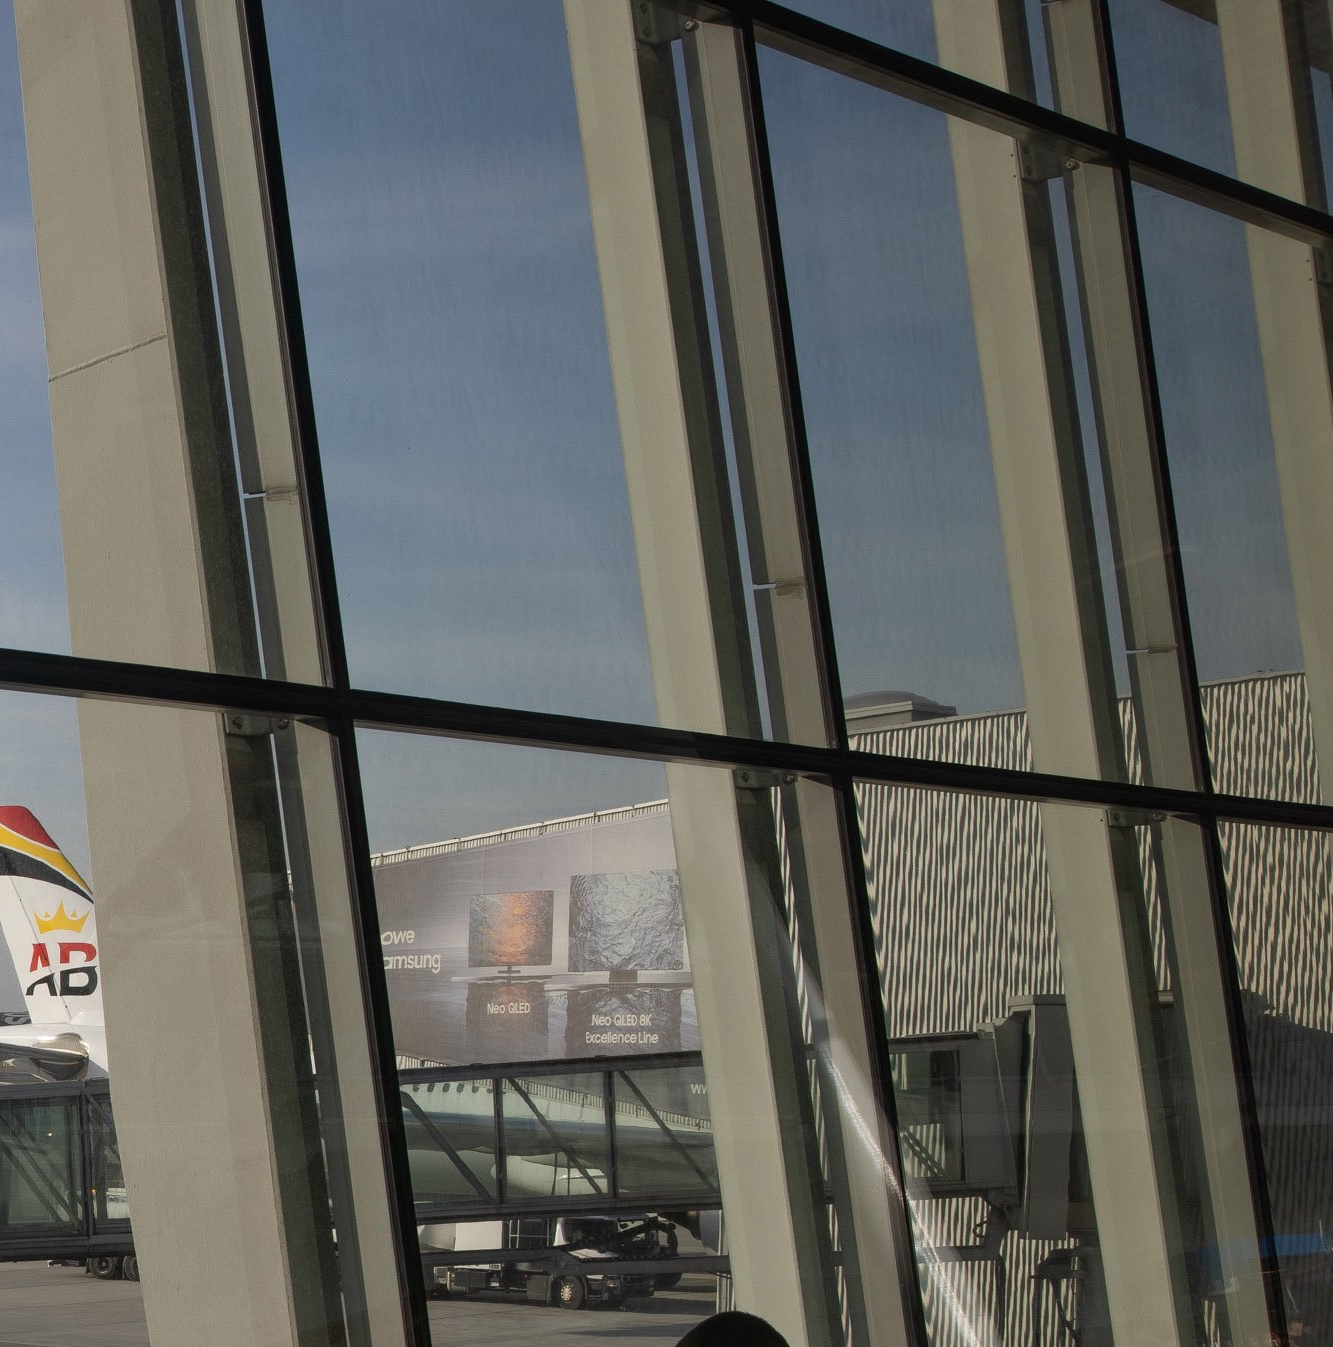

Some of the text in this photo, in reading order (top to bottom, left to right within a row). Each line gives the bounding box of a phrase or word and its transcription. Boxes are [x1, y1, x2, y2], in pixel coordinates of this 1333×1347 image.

[381, 928, 415, 945] owe
[25, 942, 98, 997] AB
[383, 953, 441, 974] amsung
[487, 1002, 531, 1014] Neo QLED
[591, 1014, 652, 1026] Neo QLED 8K
[585, 1031, 659, 1044] Excellence Line
